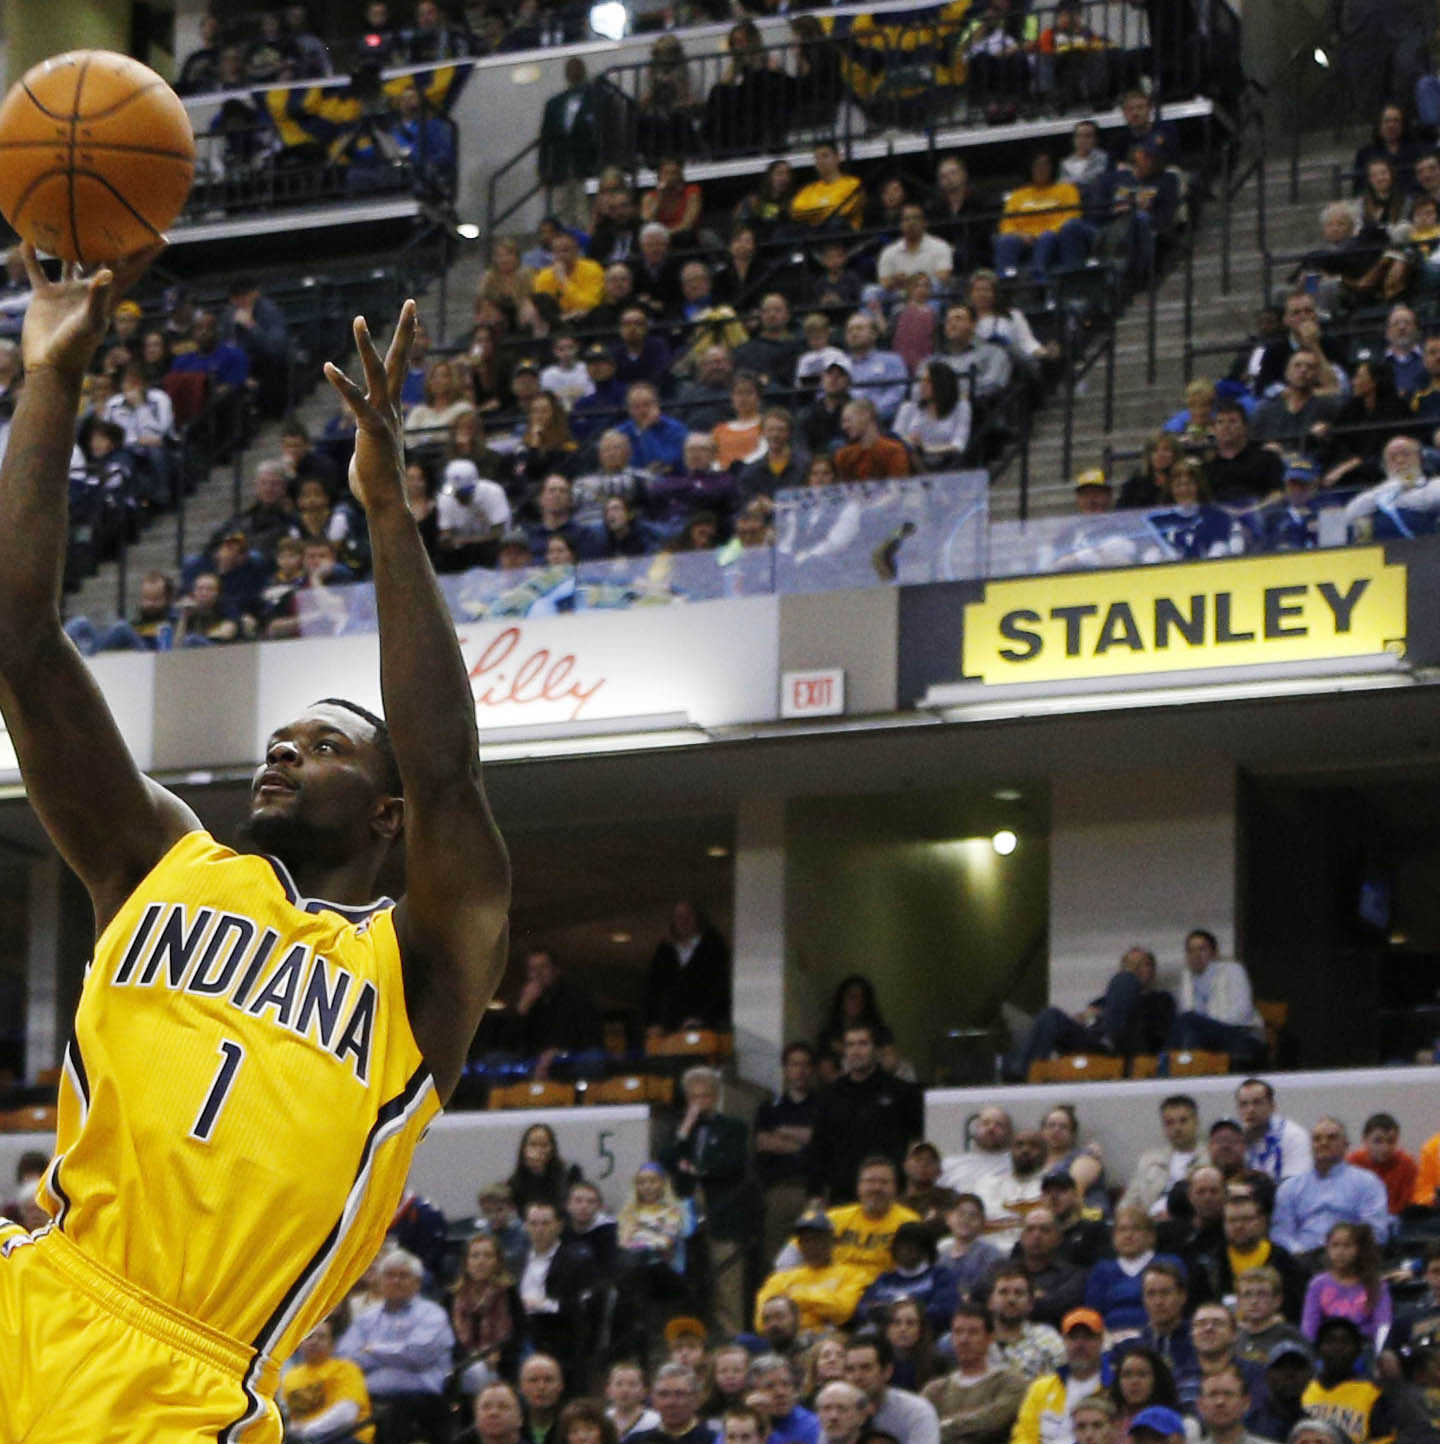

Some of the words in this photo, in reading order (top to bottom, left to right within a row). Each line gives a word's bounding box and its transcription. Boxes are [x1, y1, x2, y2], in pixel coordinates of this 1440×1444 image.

[997, 578, 1372, 663] STANLEY
[793, 677, 834, 711] EXIT
[111, 902, 379, 1089] INDIANA
[188, 1037, 247, 1143] 1
